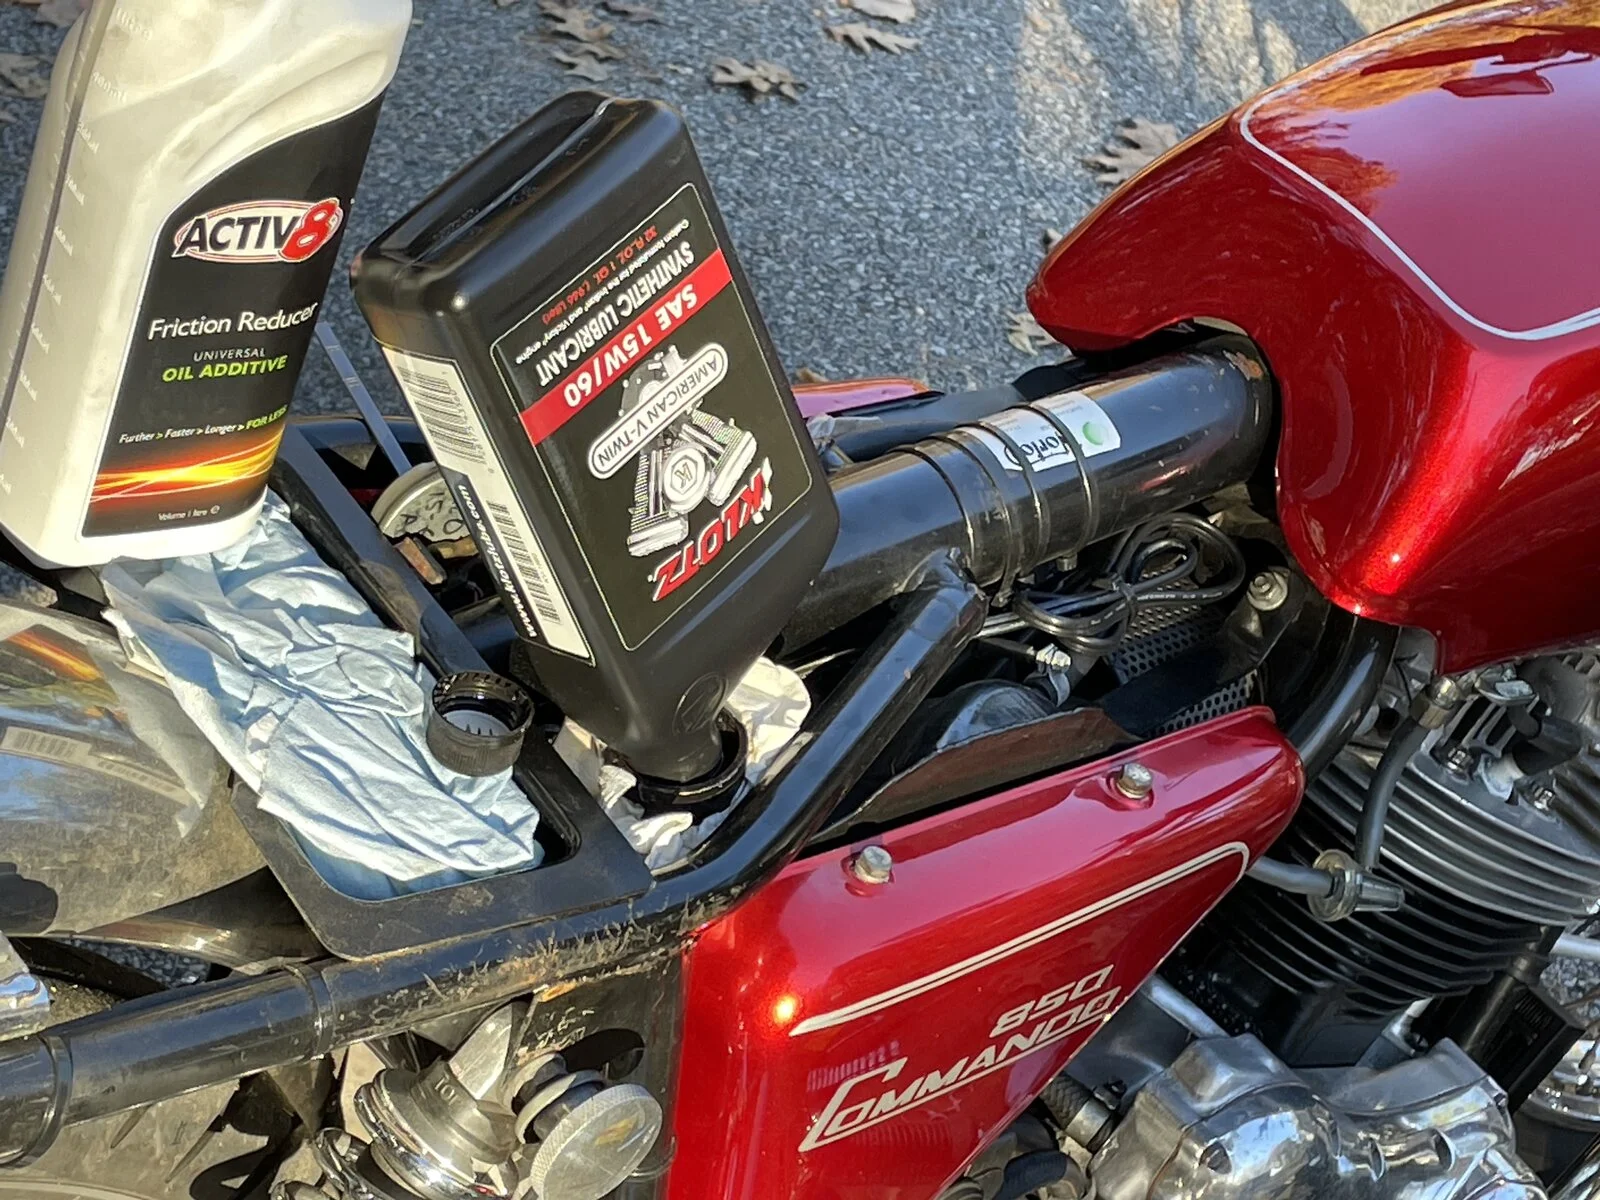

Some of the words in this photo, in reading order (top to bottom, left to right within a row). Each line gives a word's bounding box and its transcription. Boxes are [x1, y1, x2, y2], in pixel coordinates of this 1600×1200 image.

[172, 198, 339, 262] ACTIV8
[608, 272, 621, 286] the
[617, 240, 695, 317] SYNTHETIC
[148, 315, 231, 341] Friction
[237, 302, 318, 332] Reducer
[568, 304, 584, 321] and
[654, 283, 698, 331] SAE
[162, 364, 194, 383] OIL
[199, 354, 288, 380] ADDITIVE
[193, 347, 266, 363] UNIVERSAL
[515, 340, 543, 365] engine
[535, 303, 620, 388] LUBRICANT
[563, 322, 653, 407] 15W/60
[645, 354, 718, 424] AMERICAN
[118, 432, 156, 444] Further
[164, 428, 195, 439] Faster
[204, 424, 237, 436] Longer
[246, 415, 268, 430] FOR
[597, 421, 650, 467] V-TWIN
[158, 511, 187, 521] Volume
[652, 465, 769, 602] KLOTZ
[459, 484, 538, 639] www.klotzlube.com
[989, 964, 1114, 1039] 850
[798, 986, 1122, 1153] COMMANDO
